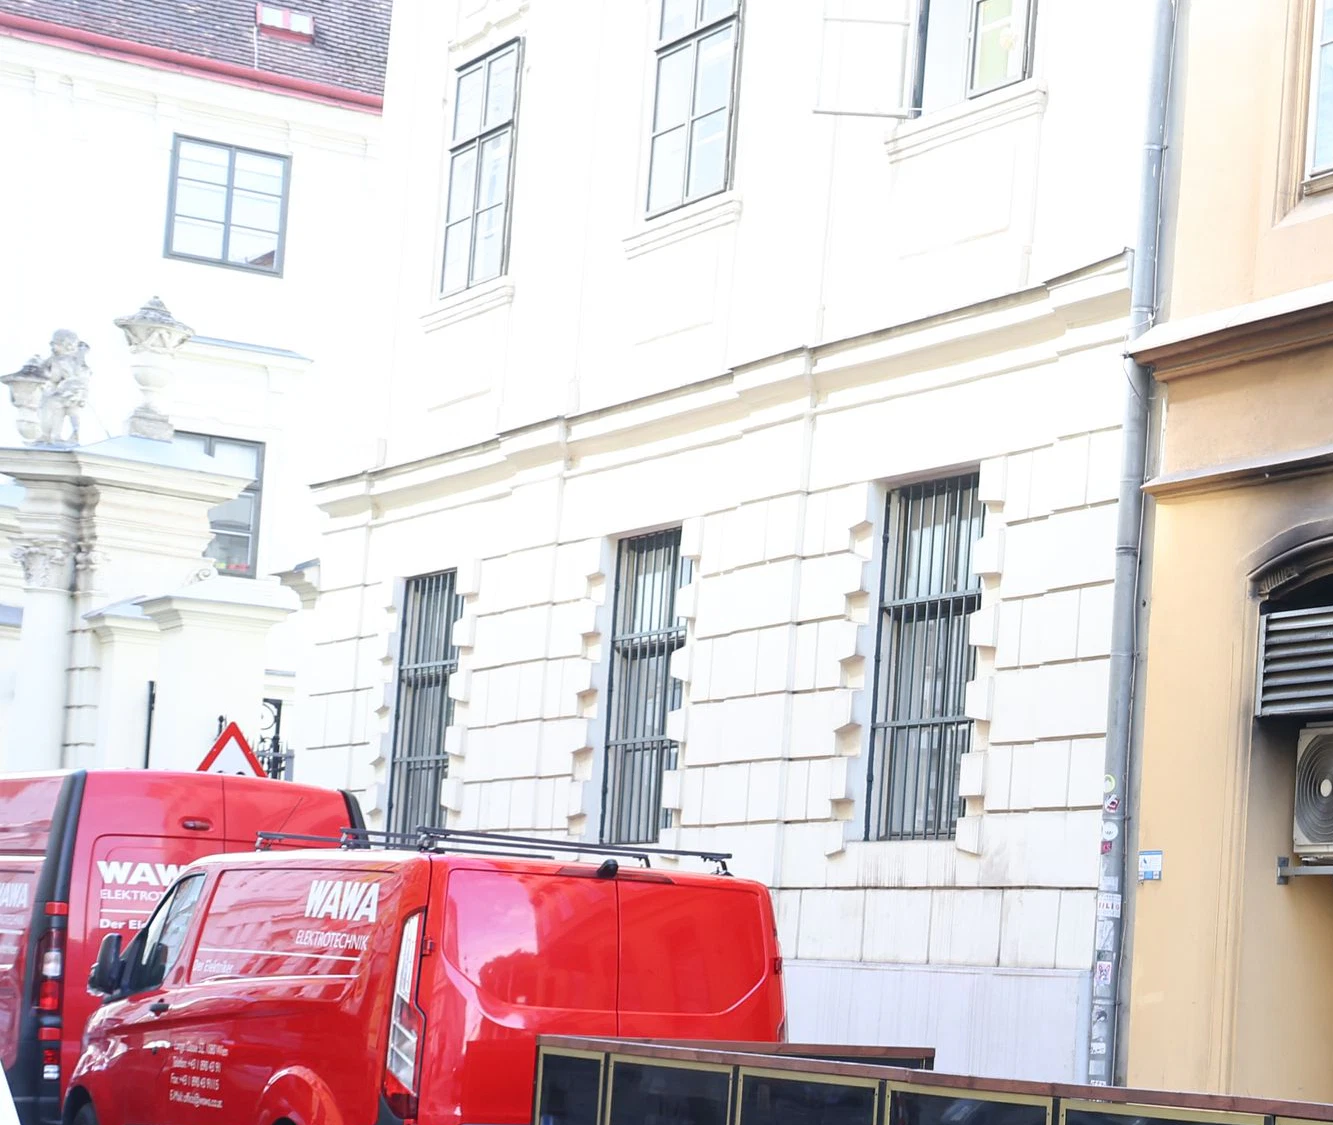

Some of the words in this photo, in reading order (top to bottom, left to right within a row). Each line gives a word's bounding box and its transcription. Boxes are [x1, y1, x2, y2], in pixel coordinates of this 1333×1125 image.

[304, 880, 381, 922] WAWA
[99, 919, 126, 929] Der
[295, 929, 370, 950] ELEKTROTECHNIK
